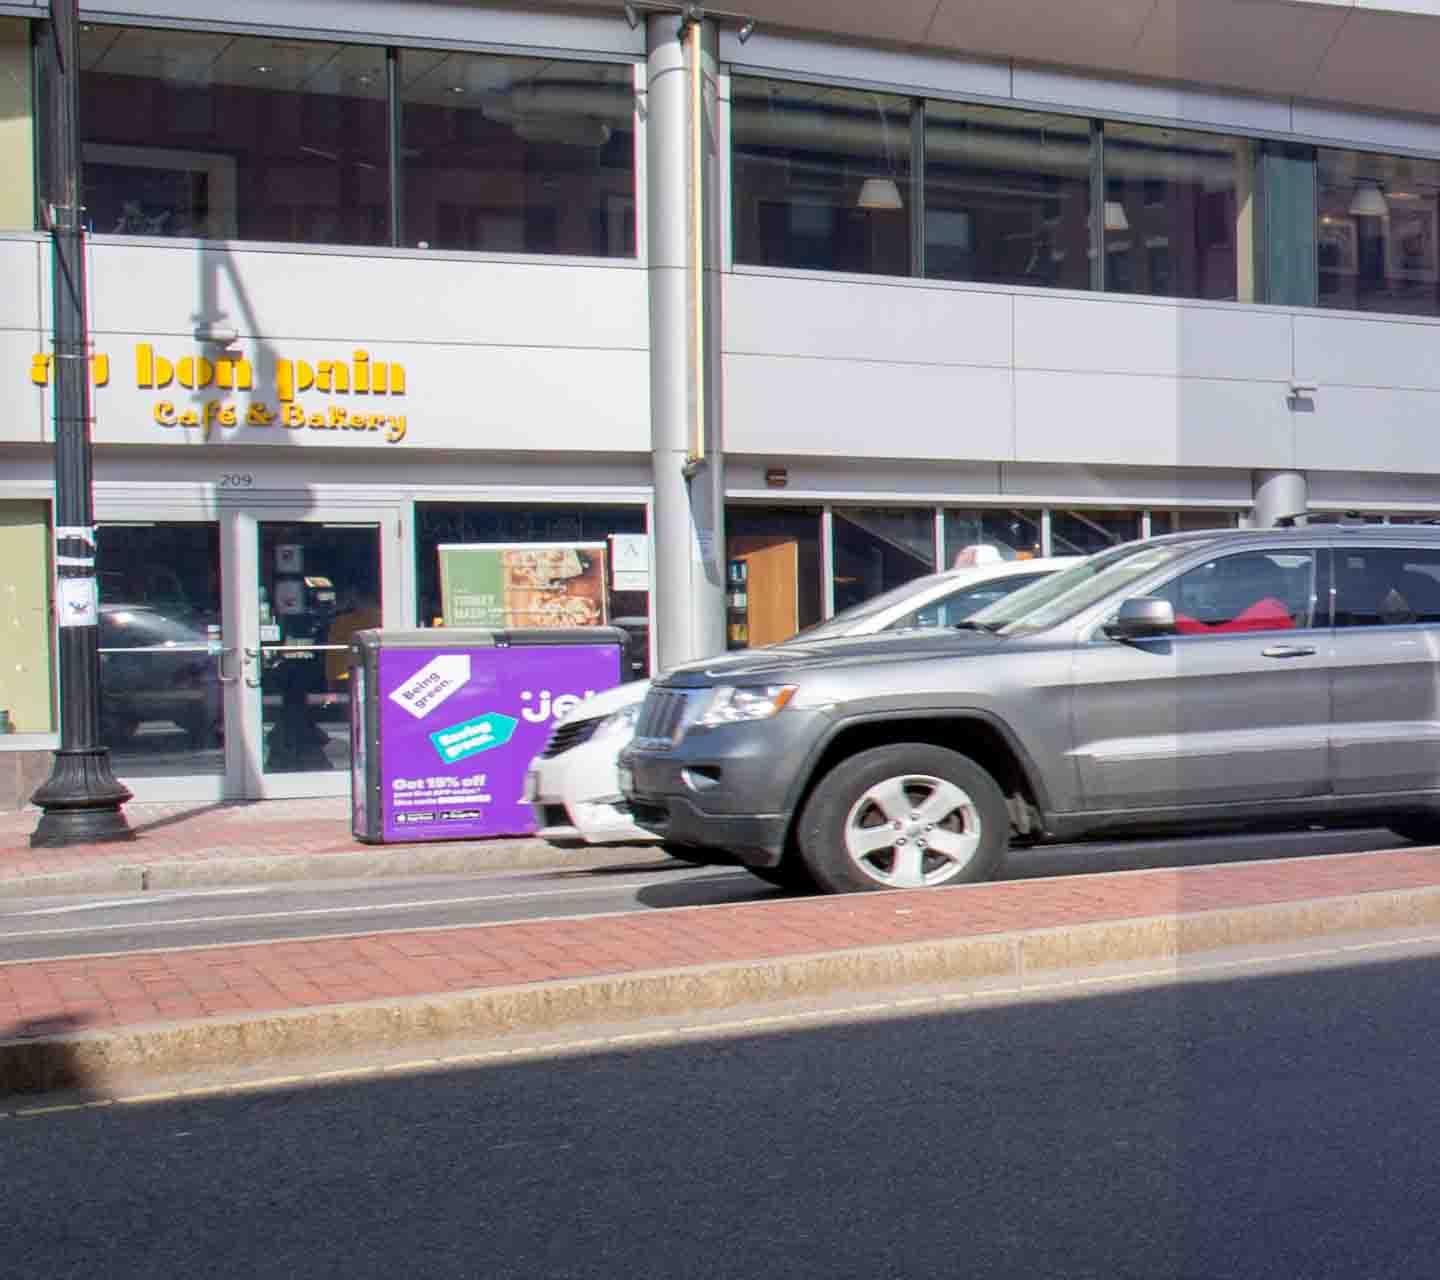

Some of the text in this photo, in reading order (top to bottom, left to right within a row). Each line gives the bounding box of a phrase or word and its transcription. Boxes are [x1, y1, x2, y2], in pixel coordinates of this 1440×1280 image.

[136, 343, 253, 391] bon
[276, 350, 407, 401] pain
[153, 401, 237, 431] Café
[247, 402, 278, 426] &
[219, 474, 255, 488] 209
[402, 672, 441, 701] Being
[520, 690, 593, 722] je
